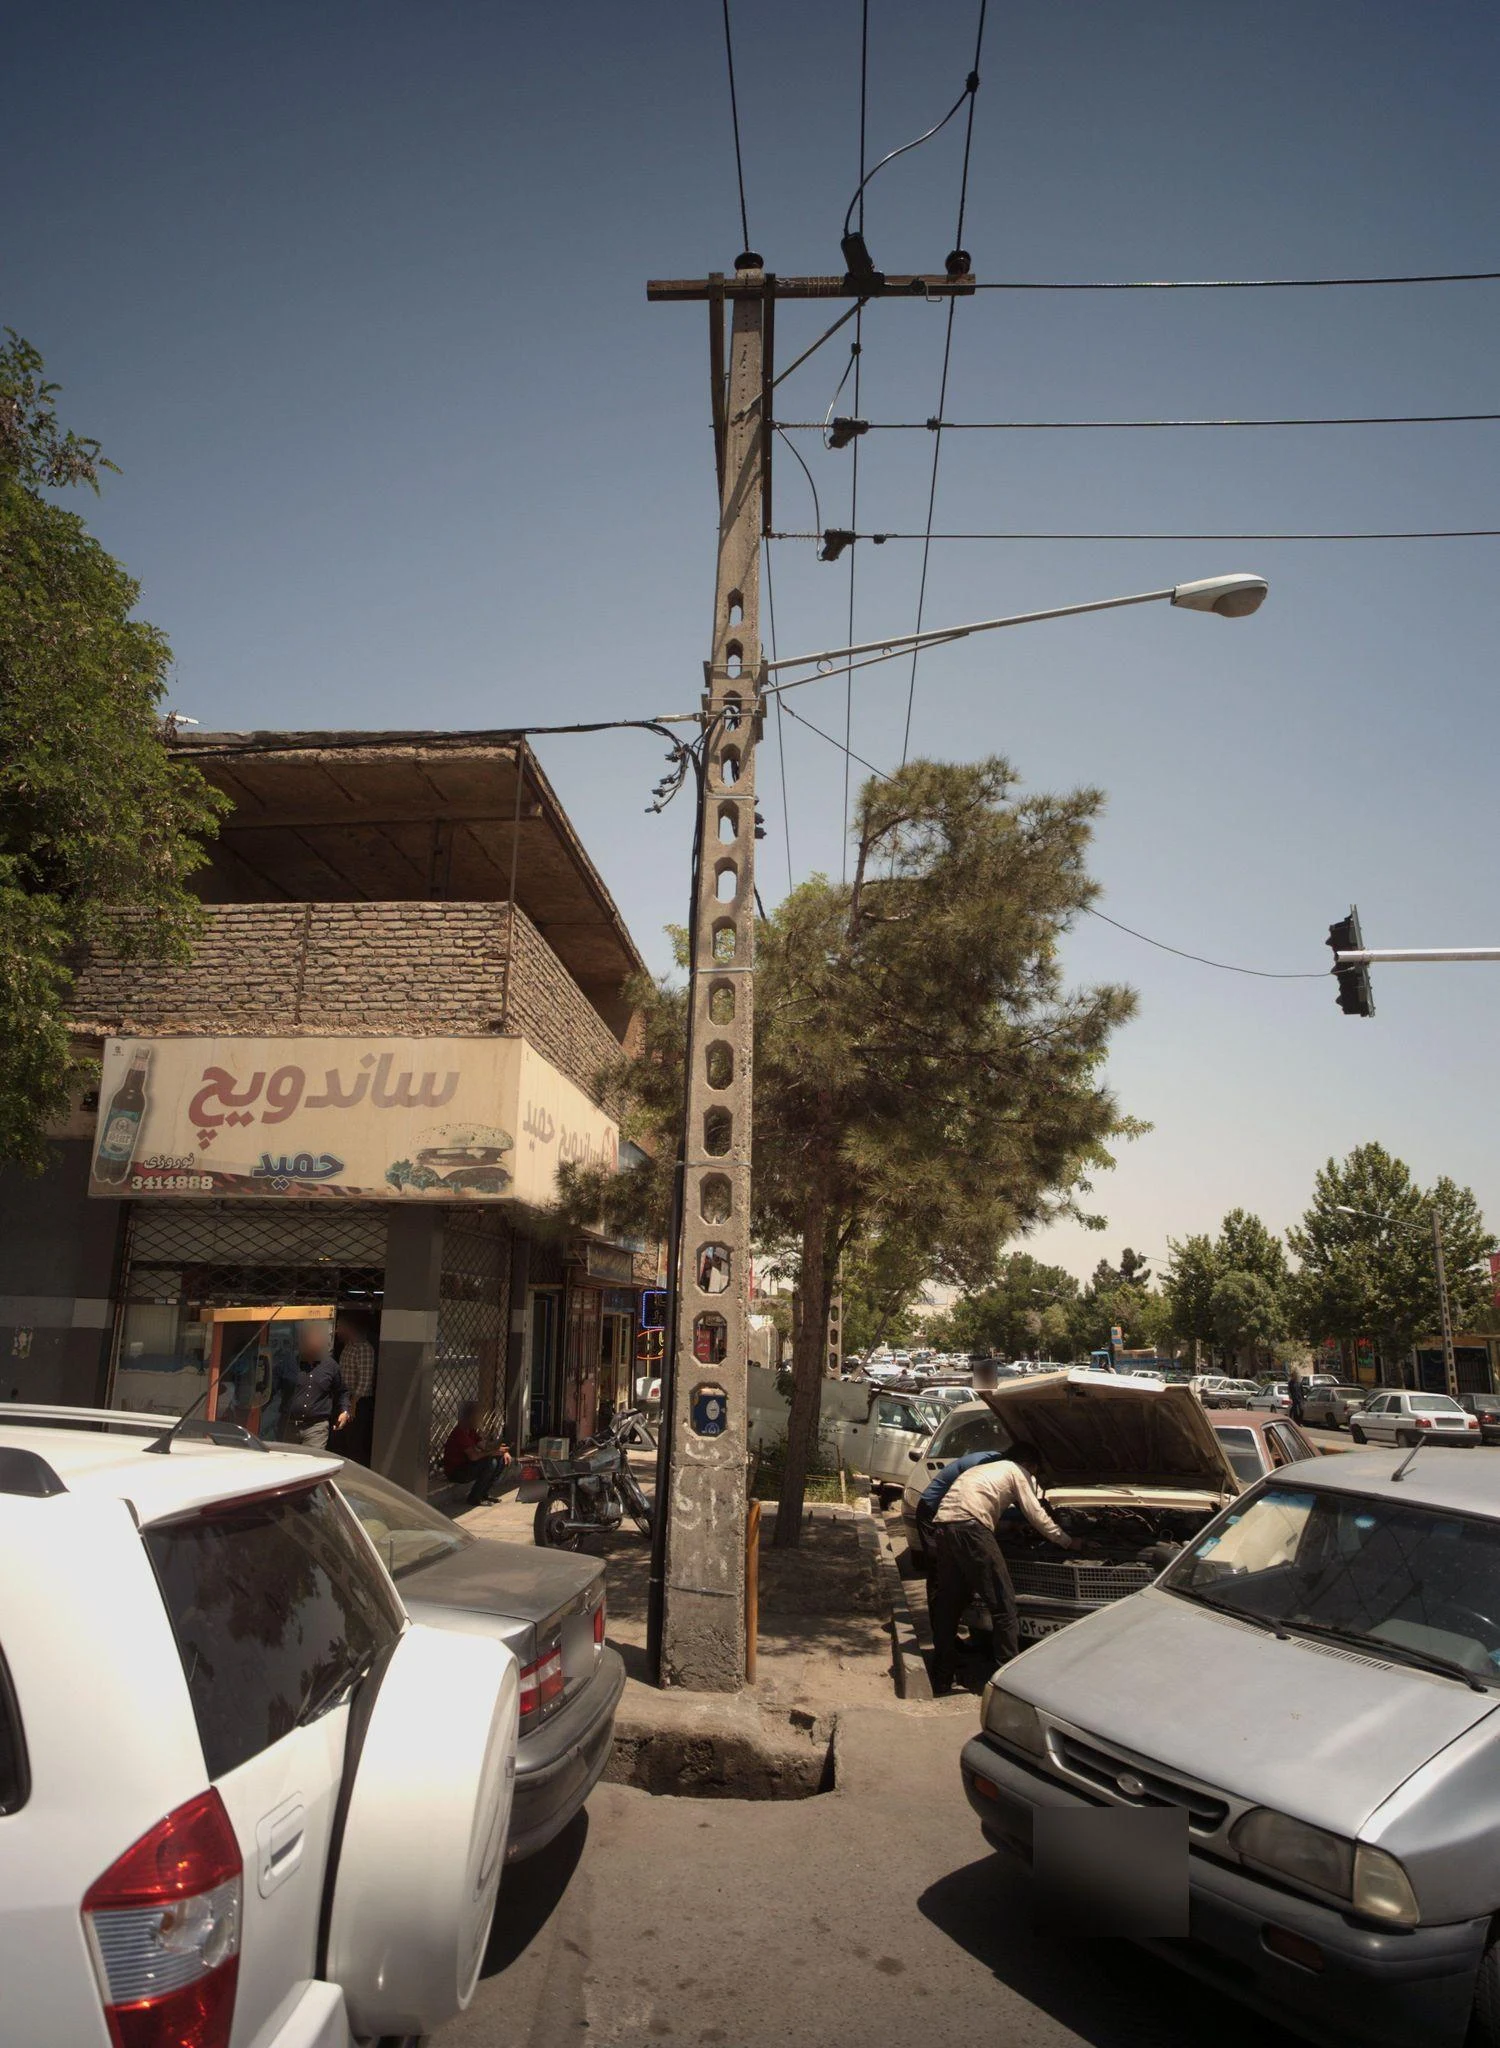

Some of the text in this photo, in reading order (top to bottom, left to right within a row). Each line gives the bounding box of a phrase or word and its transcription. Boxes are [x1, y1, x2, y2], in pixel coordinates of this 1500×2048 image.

[188, 1052, 461, 1151] ساندویچ
[523, 1100, 555, 1153] حمید
[143, 1152, 195, 1170] نوروزی
[251, 1151, 345, 1191] حمید
[131, 1175, 214, 1190] 3414888
